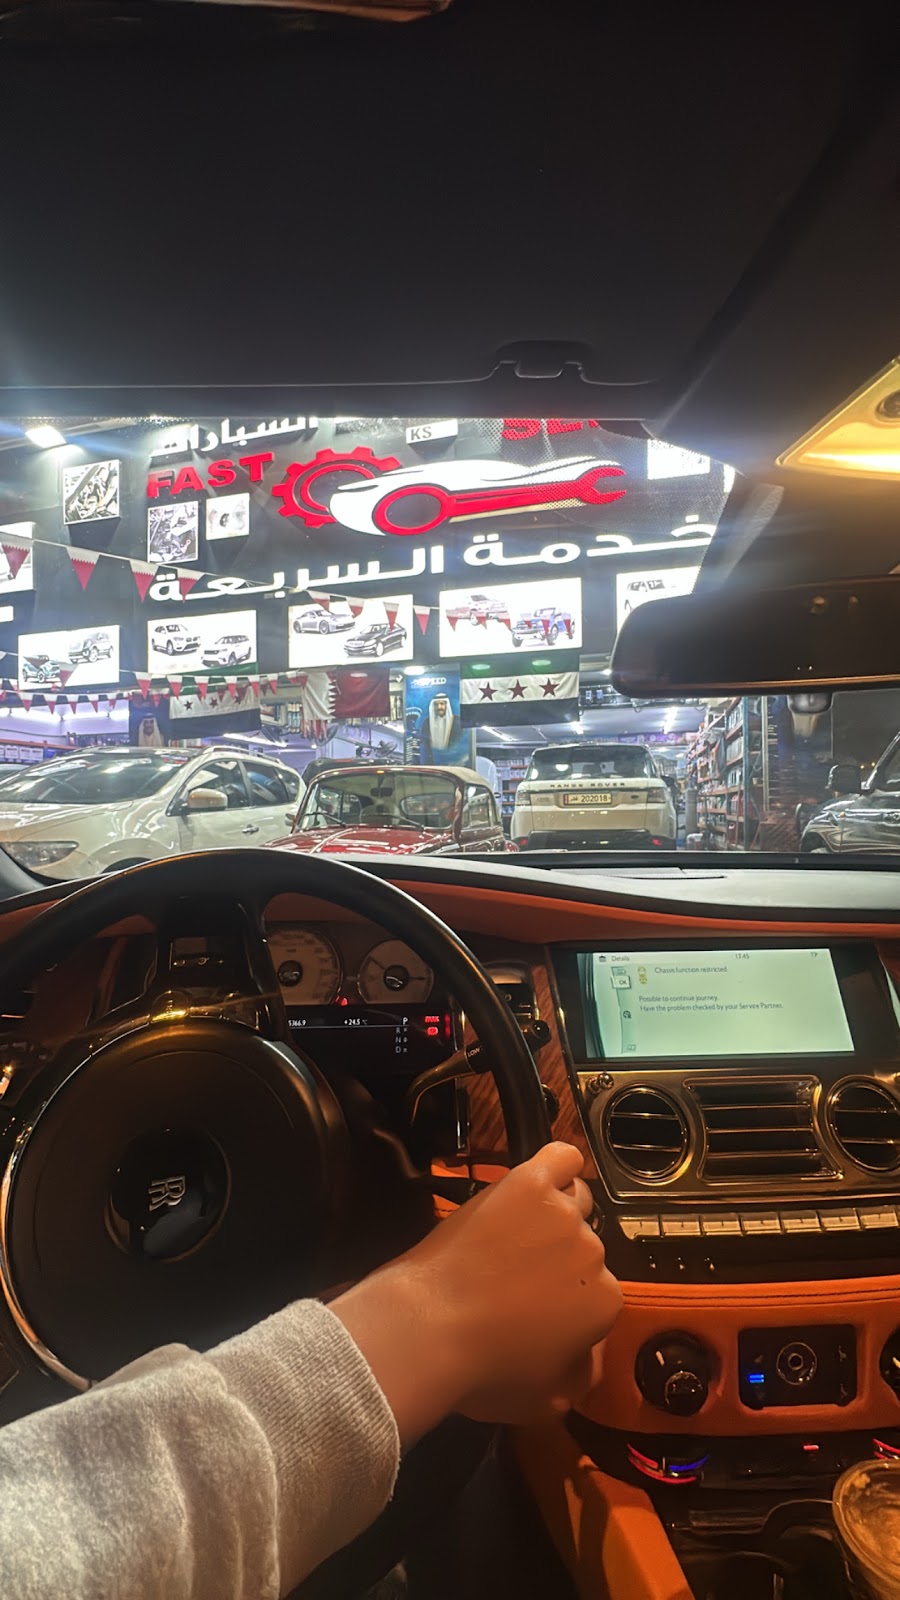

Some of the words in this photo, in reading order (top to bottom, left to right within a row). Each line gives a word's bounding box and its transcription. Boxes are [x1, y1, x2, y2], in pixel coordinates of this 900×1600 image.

[410, 426, 432, 441] KS
[501, 418, 598, 440] SE
[147, 452, 274, 498] FAST
[463, 514, 717, 566] خدمة
[149, 545, 444, 602] السريعة
[581, 795, 608, 803] 202018
[654, 966, 675, 974] Chassis
[675, 965, 700, 973] function
[700, 965, 728, 973] restricted
[667, 1004, 691, 1012] problem
[692, 1003, 716, 1011] checked
[716, 1003, 724, 1011] by
[724, 1004, 738, 1012] your
[402, 1016, 409, 1026] P
[395, 1045, 401, 1053] D
[467, 1046, 481, 1058] LOW
